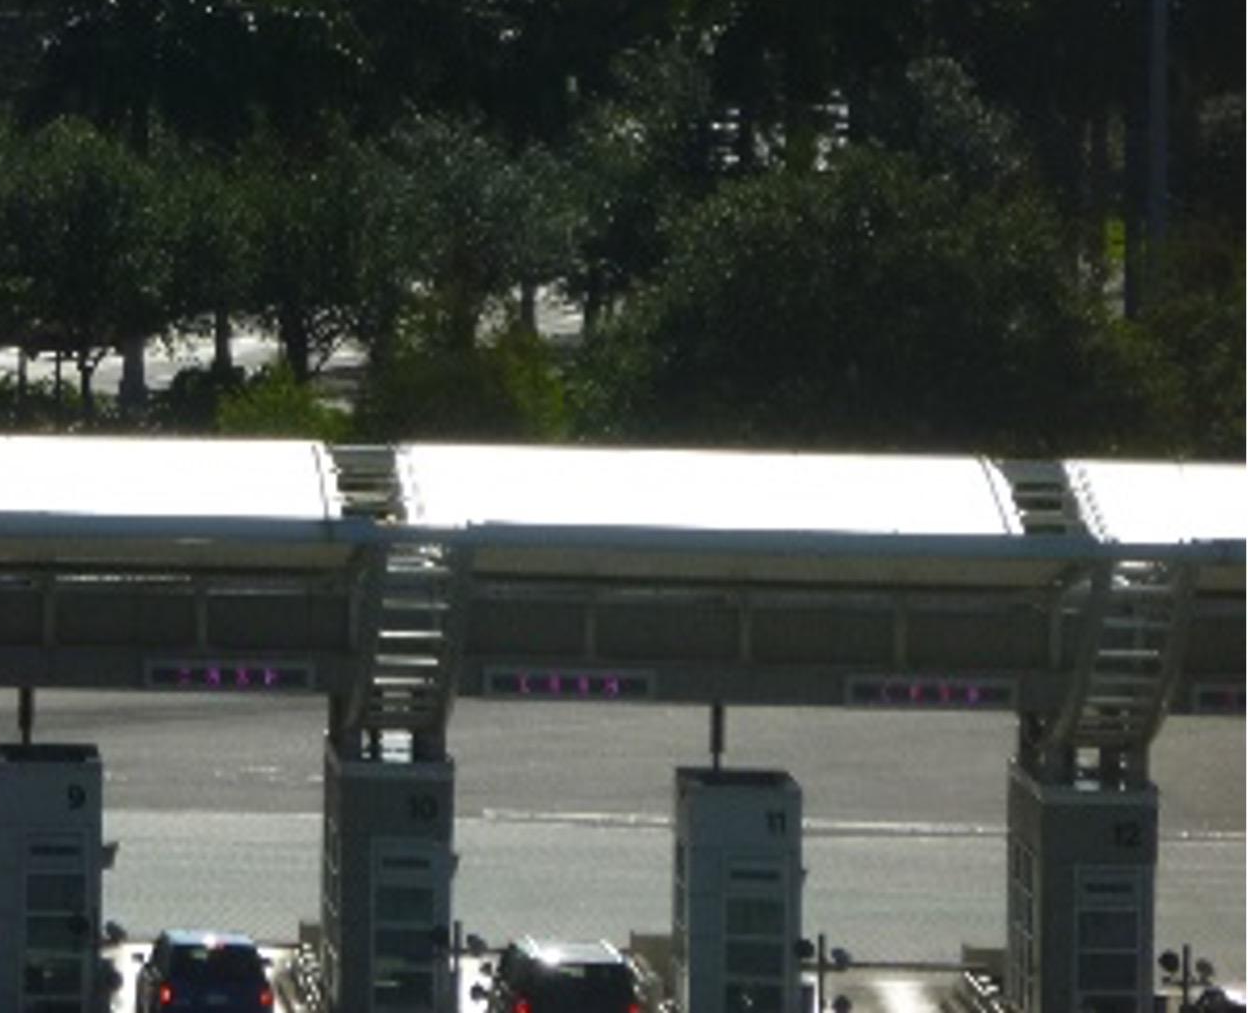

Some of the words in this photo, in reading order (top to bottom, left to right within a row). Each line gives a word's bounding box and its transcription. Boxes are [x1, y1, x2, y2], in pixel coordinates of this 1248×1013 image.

[68, 784, 85, 810] 9
[410, 794, 438, 819] 10
[765, 810, 786, 834] 11
[1114, 820, 1142, 846] 12
